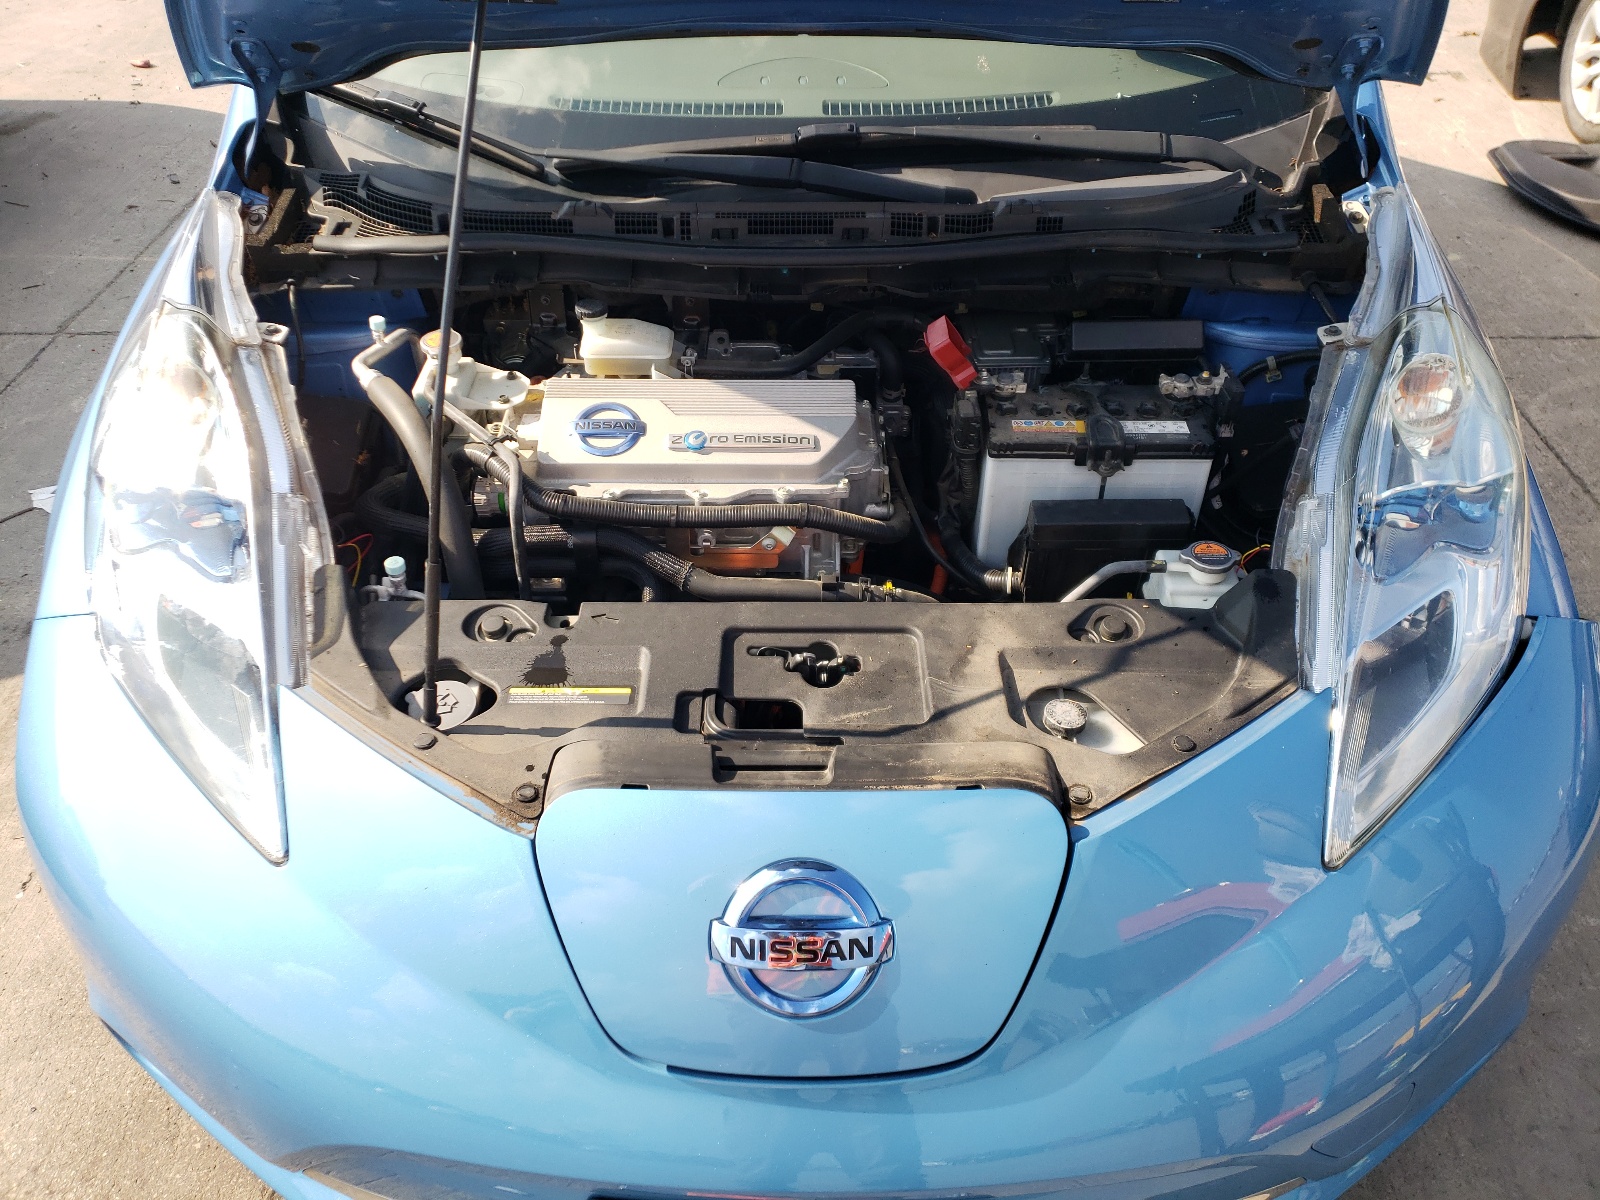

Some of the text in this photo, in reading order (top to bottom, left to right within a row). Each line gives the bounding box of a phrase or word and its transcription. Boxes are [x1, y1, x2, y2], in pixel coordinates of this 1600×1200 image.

[575, 421, 638, 431] NISSAN
[733, 433, 811, 445] Emission
[730, 936, 874, 963] NISSAN
